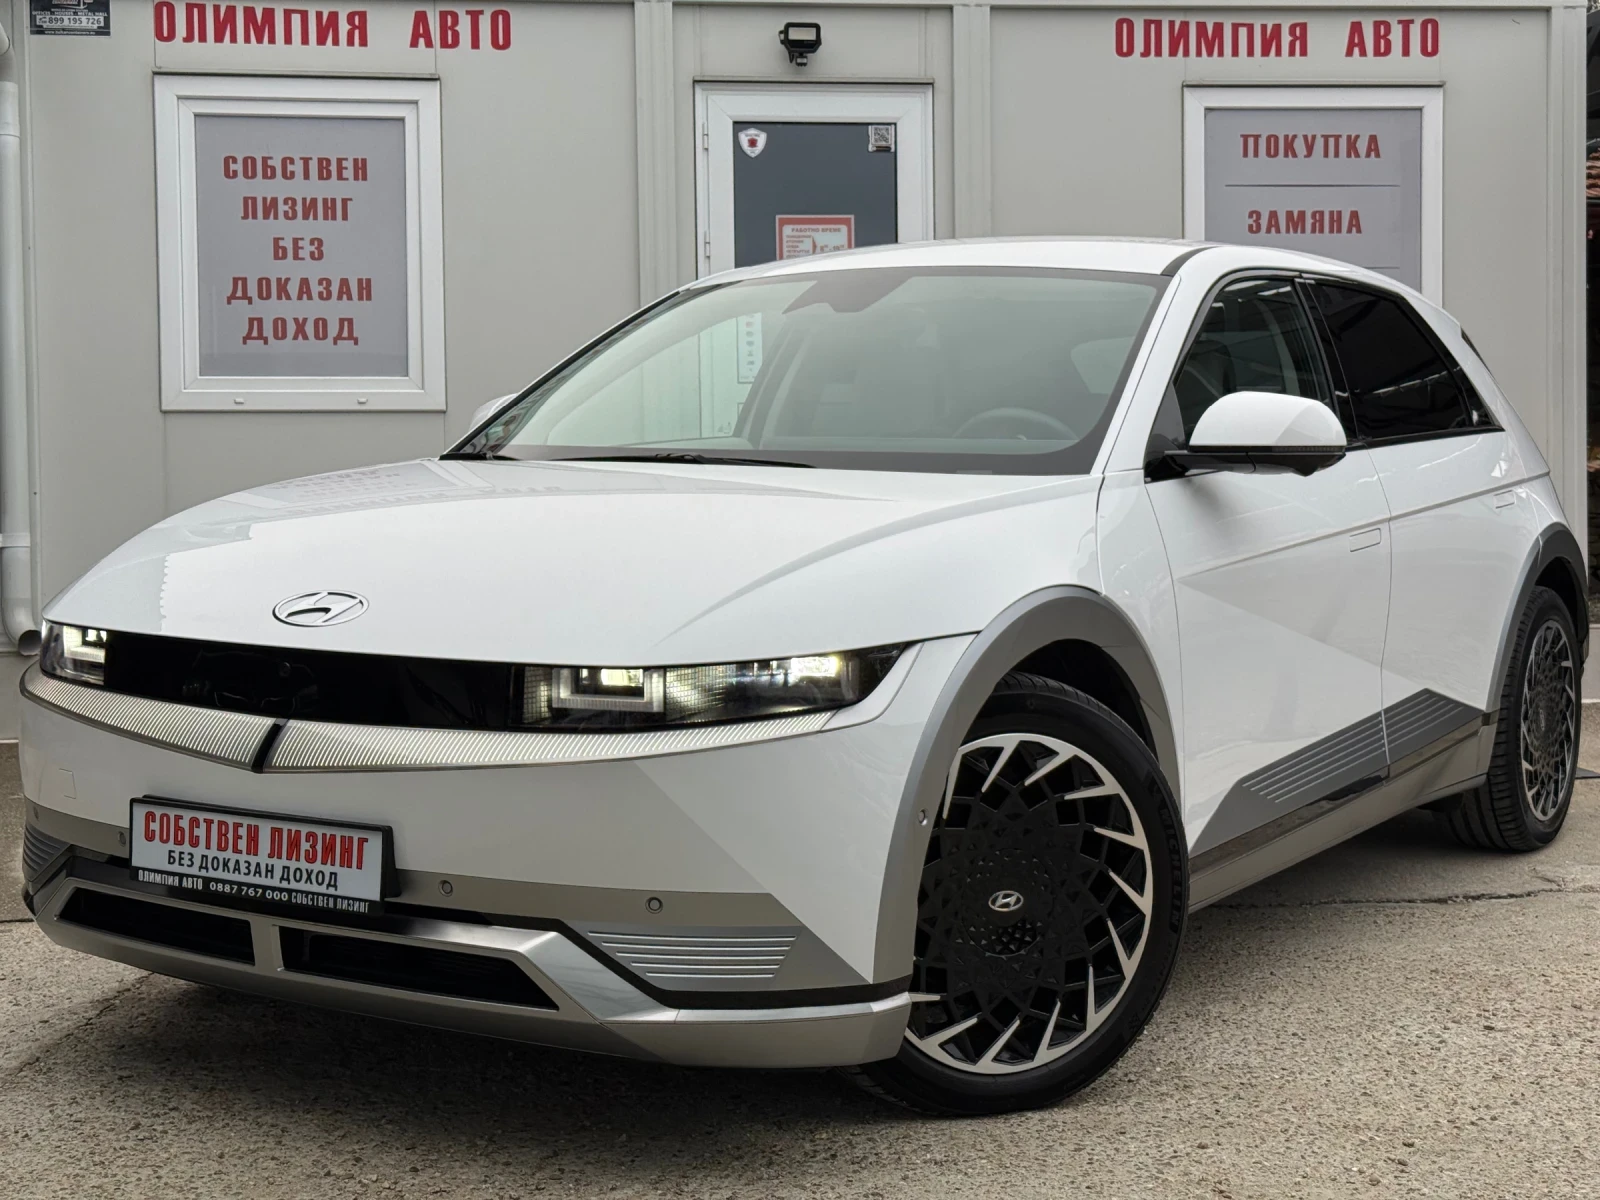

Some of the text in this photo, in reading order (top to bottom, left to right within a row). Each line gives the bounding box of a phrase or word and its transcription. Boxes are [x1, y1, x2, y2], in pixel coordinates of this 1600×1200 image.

[48, 16, 65, 25] 899
[67, 17, 83, 25] 195
[86, 17, 102, 26] 726
[154, 1, 512, 51] ОЛИМПИЯ АВТО
[1115, 17, 1440, 58] ОЛИМПИЯ АВТО
[1240, 134, 1381, 158] ПОКУПКА
[224, 156, 368, 181] СОБСТВЕН
[241, 196, 353, 221] ЛИЗИНГ
[1247, 210, 1362, 234] ЗАМЯНА
[273, 237, 324, 261] БЕЗ
[226, 277, 372, 305] ДОКАЗАН
[242, 317, 359, 346] ДОХОД
[144, 810, 369, 870] СОБСТВЕН ЛИЗИНГ
[167, 850, 339, 892] БЕЗ ДОКАЗАН ДОХОД
[1161, 808, 1182, 926] MICHELIN
[138, 869, 370, 914] ОЛИМПИЯ АВТО 0887 767 000 СОБСТВЕН ЛИЗИНГ
